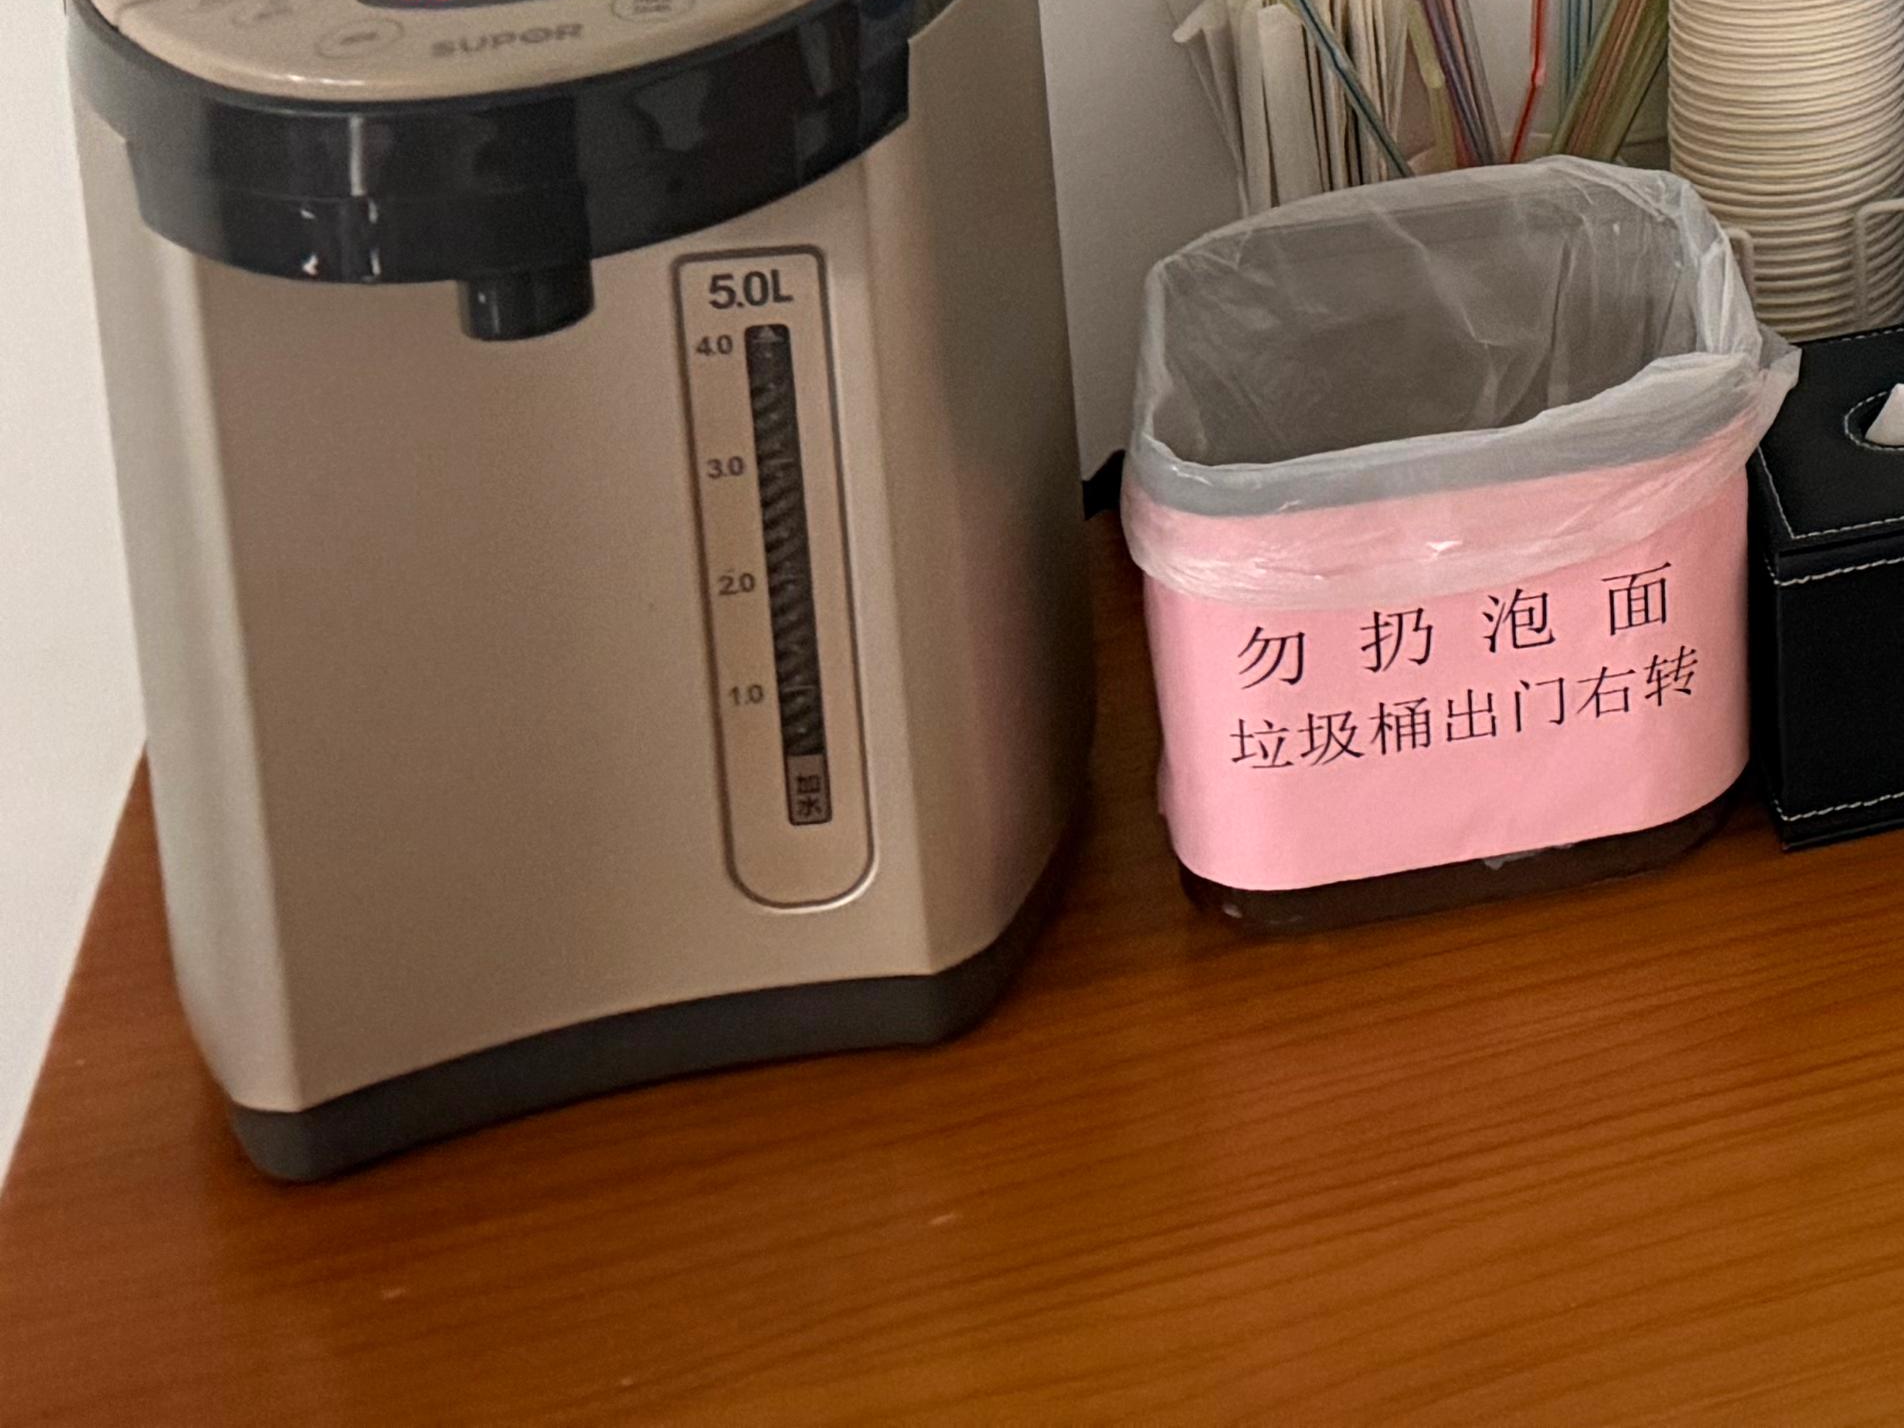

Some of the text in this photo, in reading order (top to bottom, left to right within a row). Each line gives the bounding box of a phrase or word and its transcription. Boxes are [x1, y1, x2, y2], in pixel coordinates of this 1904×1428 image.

[707, 268, 794, 310] 5.0L
[696, 333, 734, 355] 4.0
[706, 455, 745, 479] 3.0
[718, 572, 756, 596] 2.0
[729, 683, 764, 706] 1.0
[1229, 645, 1700, 770] 垃圾桶出门右转
